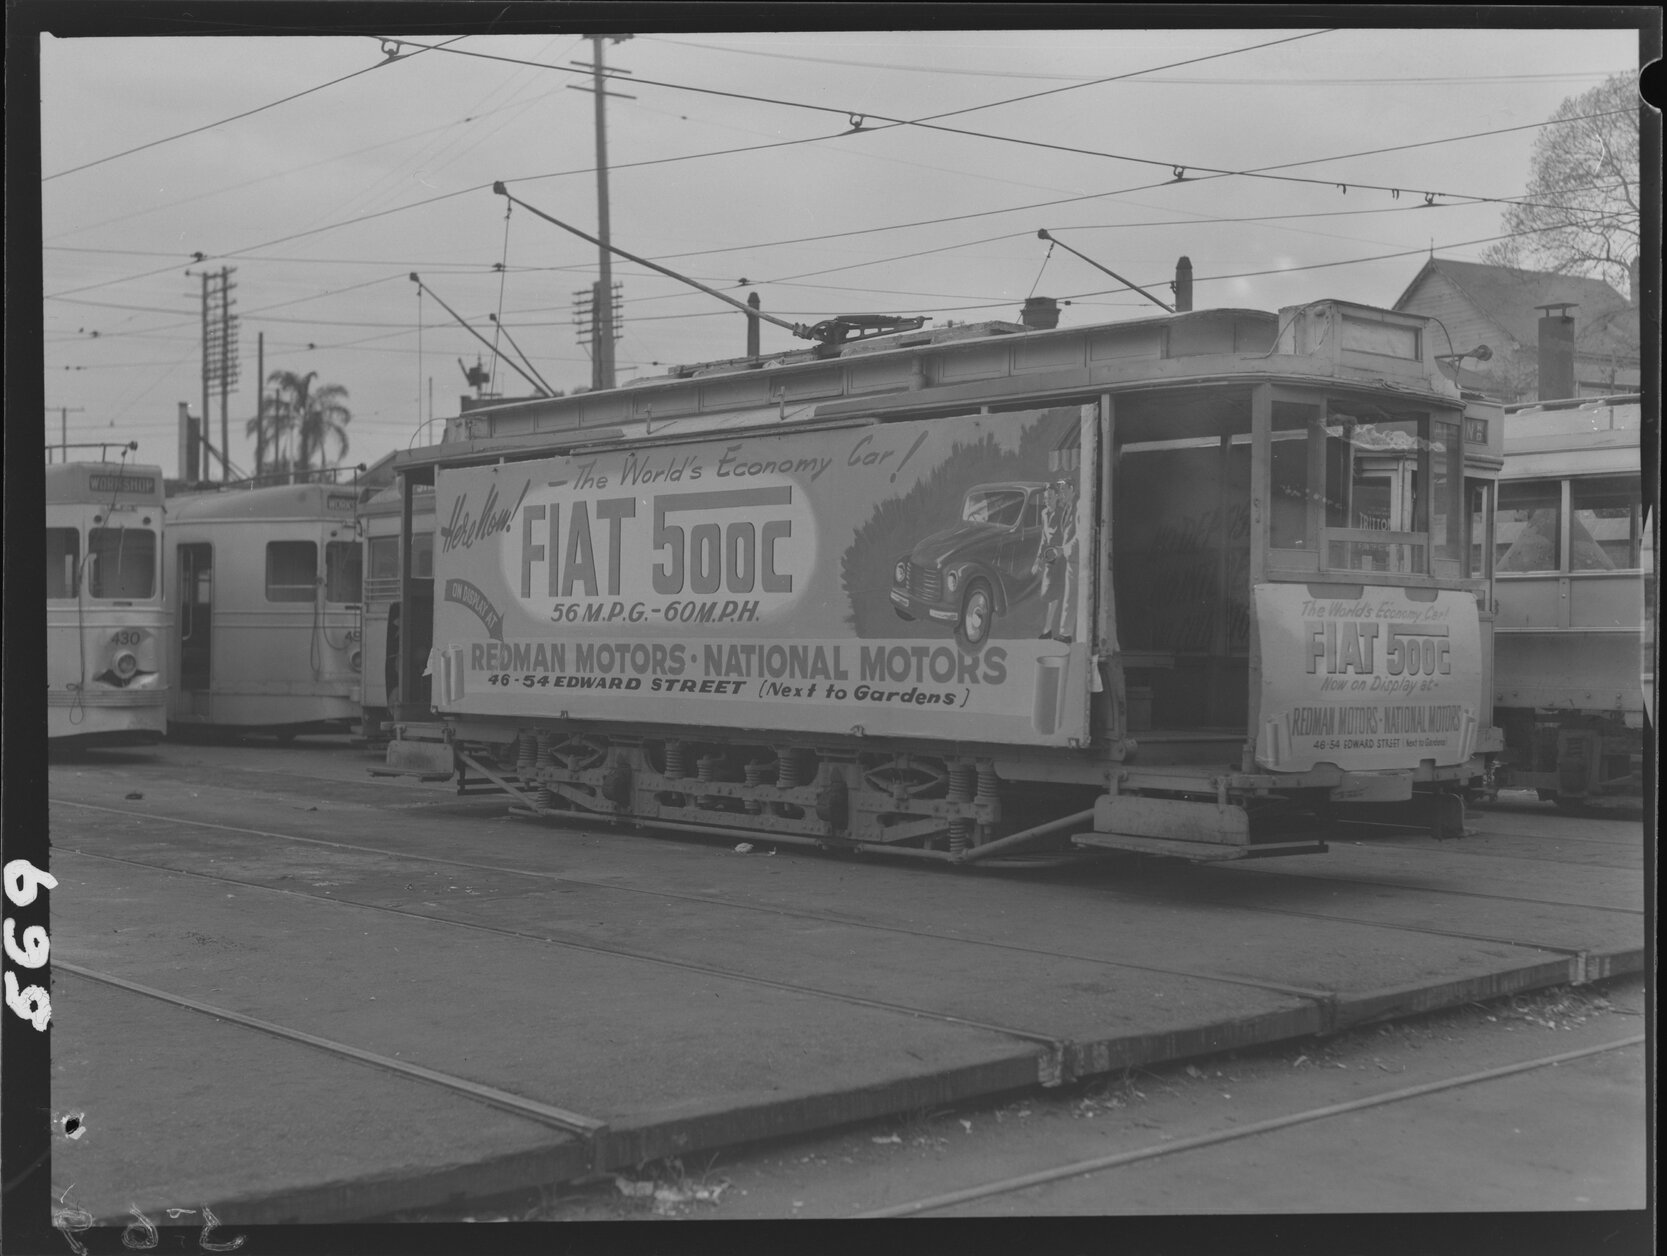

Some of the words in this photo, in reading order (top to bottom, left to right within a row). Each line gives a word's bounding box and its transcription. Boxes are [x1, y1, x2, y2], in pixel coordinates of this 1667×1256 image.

[573, 458, 609, 491] The
[620, 455, 704, 487] World's
[716, 443, 833, 483] Economy
[847, 430, 929, 484] Car!
[440, 493, 475, 553] Here
[475, 478, 531, 541] Now!
[520, 496, 637, 598] FIAT
[651, 484, 793, 596] 500C
[451, 582, 463, 600] ON
[462, 585, 489, 617] DISPLAY
[484, 611, 498, 629] AT
[550, 602, 581, 623] 56
[1301, 600, 1326, 617] The
[1328, 600, 1373, 618] World's
[1375, 600, 1421, 623] Economy
[110, 631, 141, 646] 430
[1304, 621, 1379, 675] FIAT
[1386, 622, 1451, 676] 500C
[471, 642, 566, 673] REDMAN
[575, 642, 687, 676] MOTORS
[703, 643, 849, 682] NATIONAL
[860, 645, 1008, 686] MOTORS
[553, 675, 642, 690] EDWARD
[651, 677, 747, 695] STREET
[758, 679, 817, 699] (Next
[825, 682, 848, 700] to
[853, 684, 970, 708] Gardens)
[1321, 676, 1348, 692] Now
[1350, 679, 1367, 692] on
[1369, 675, 1418, 697] Display
[1292, 706, 1336, 737] REDMAN
[1338, 706, 1379, 736] MOTORS
[1384, 705, 1427, 735] NATIONAL
[1428, 704, 1462, 733] MOTORS
[1343, 738, 1375, 749] EDWARD
[1376, 738, 1401, 749] STREET
